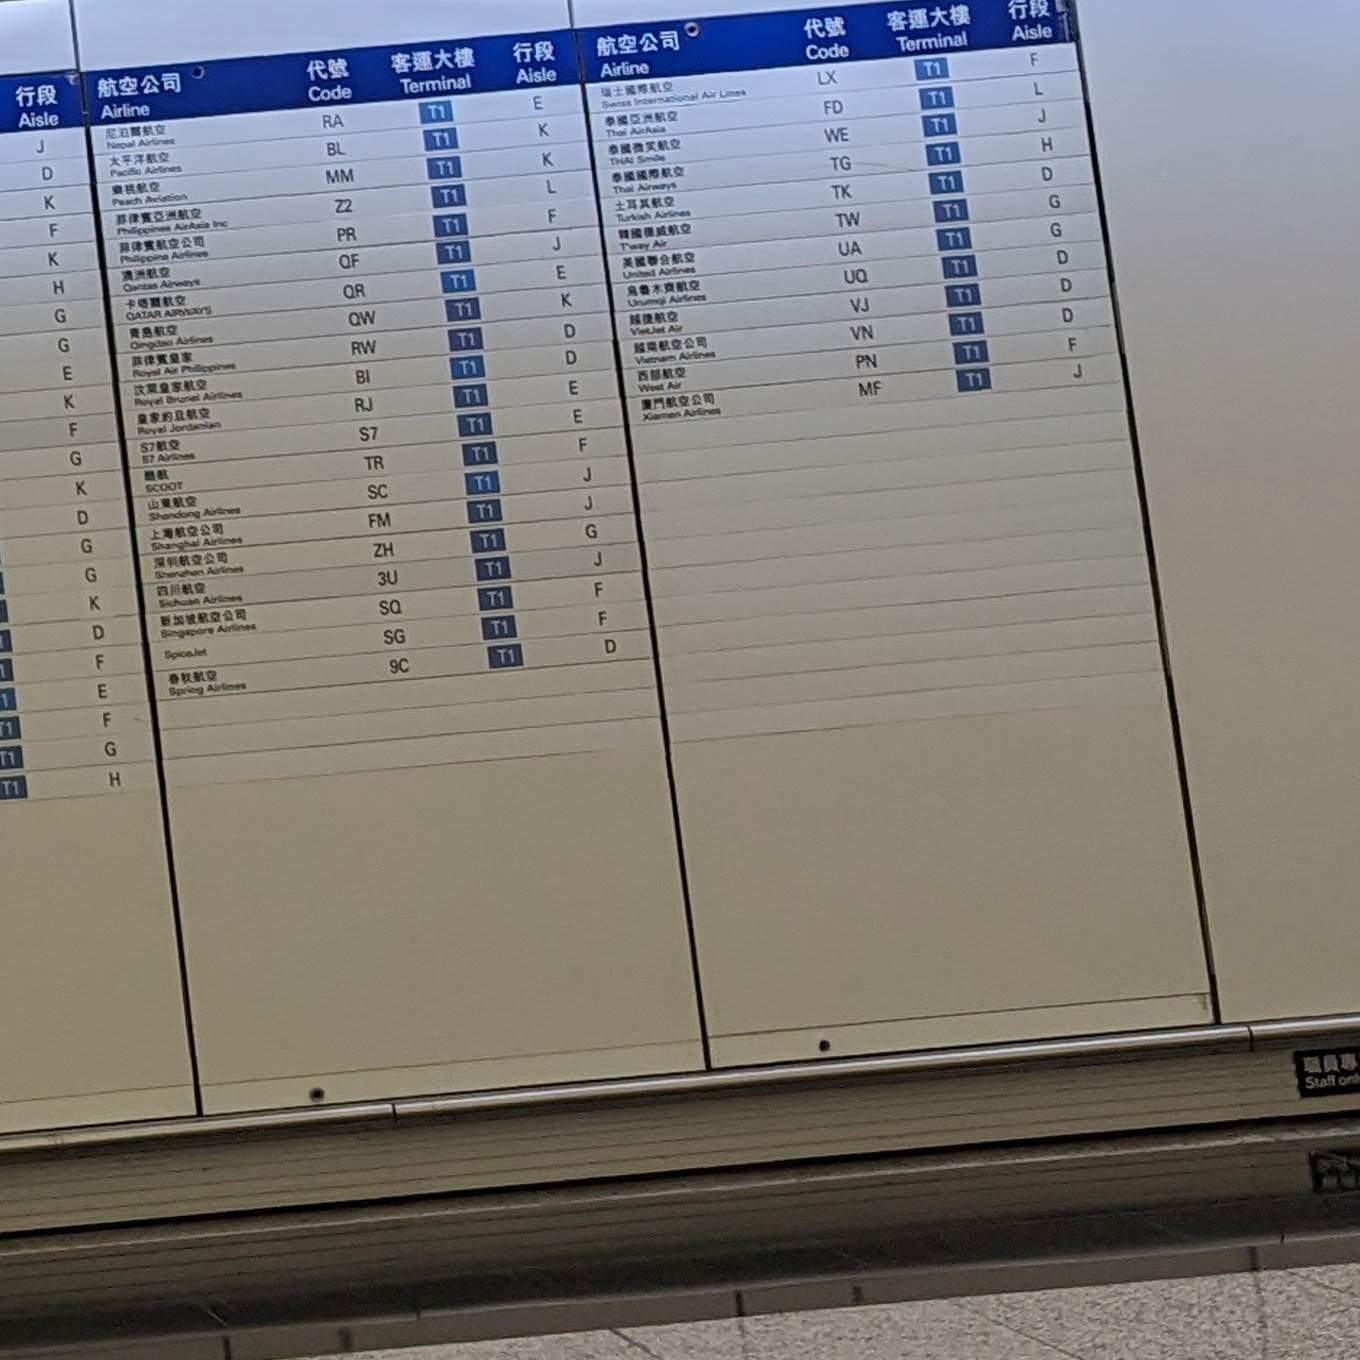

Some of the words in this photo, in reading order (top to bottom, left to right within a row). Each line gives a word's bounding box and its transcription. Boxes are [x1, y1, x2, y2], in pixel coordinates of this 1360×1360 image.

[600, 61, 649, 78] Airline
[308, 84, 352, 101] Code
[399, 73, 472, 93] Terminal
[516, 66, 557, 84] Aisle
[15, 84, 58, 107] 行段
[18, 111, 59, 128] Aisle
[823, 127, 849, 143] WE
[829, 155, 852, 171] TG
[325, 168, 354, 184] MM
[837, 240, 863, 257] UA
[348, 310, 375, 327] QW
